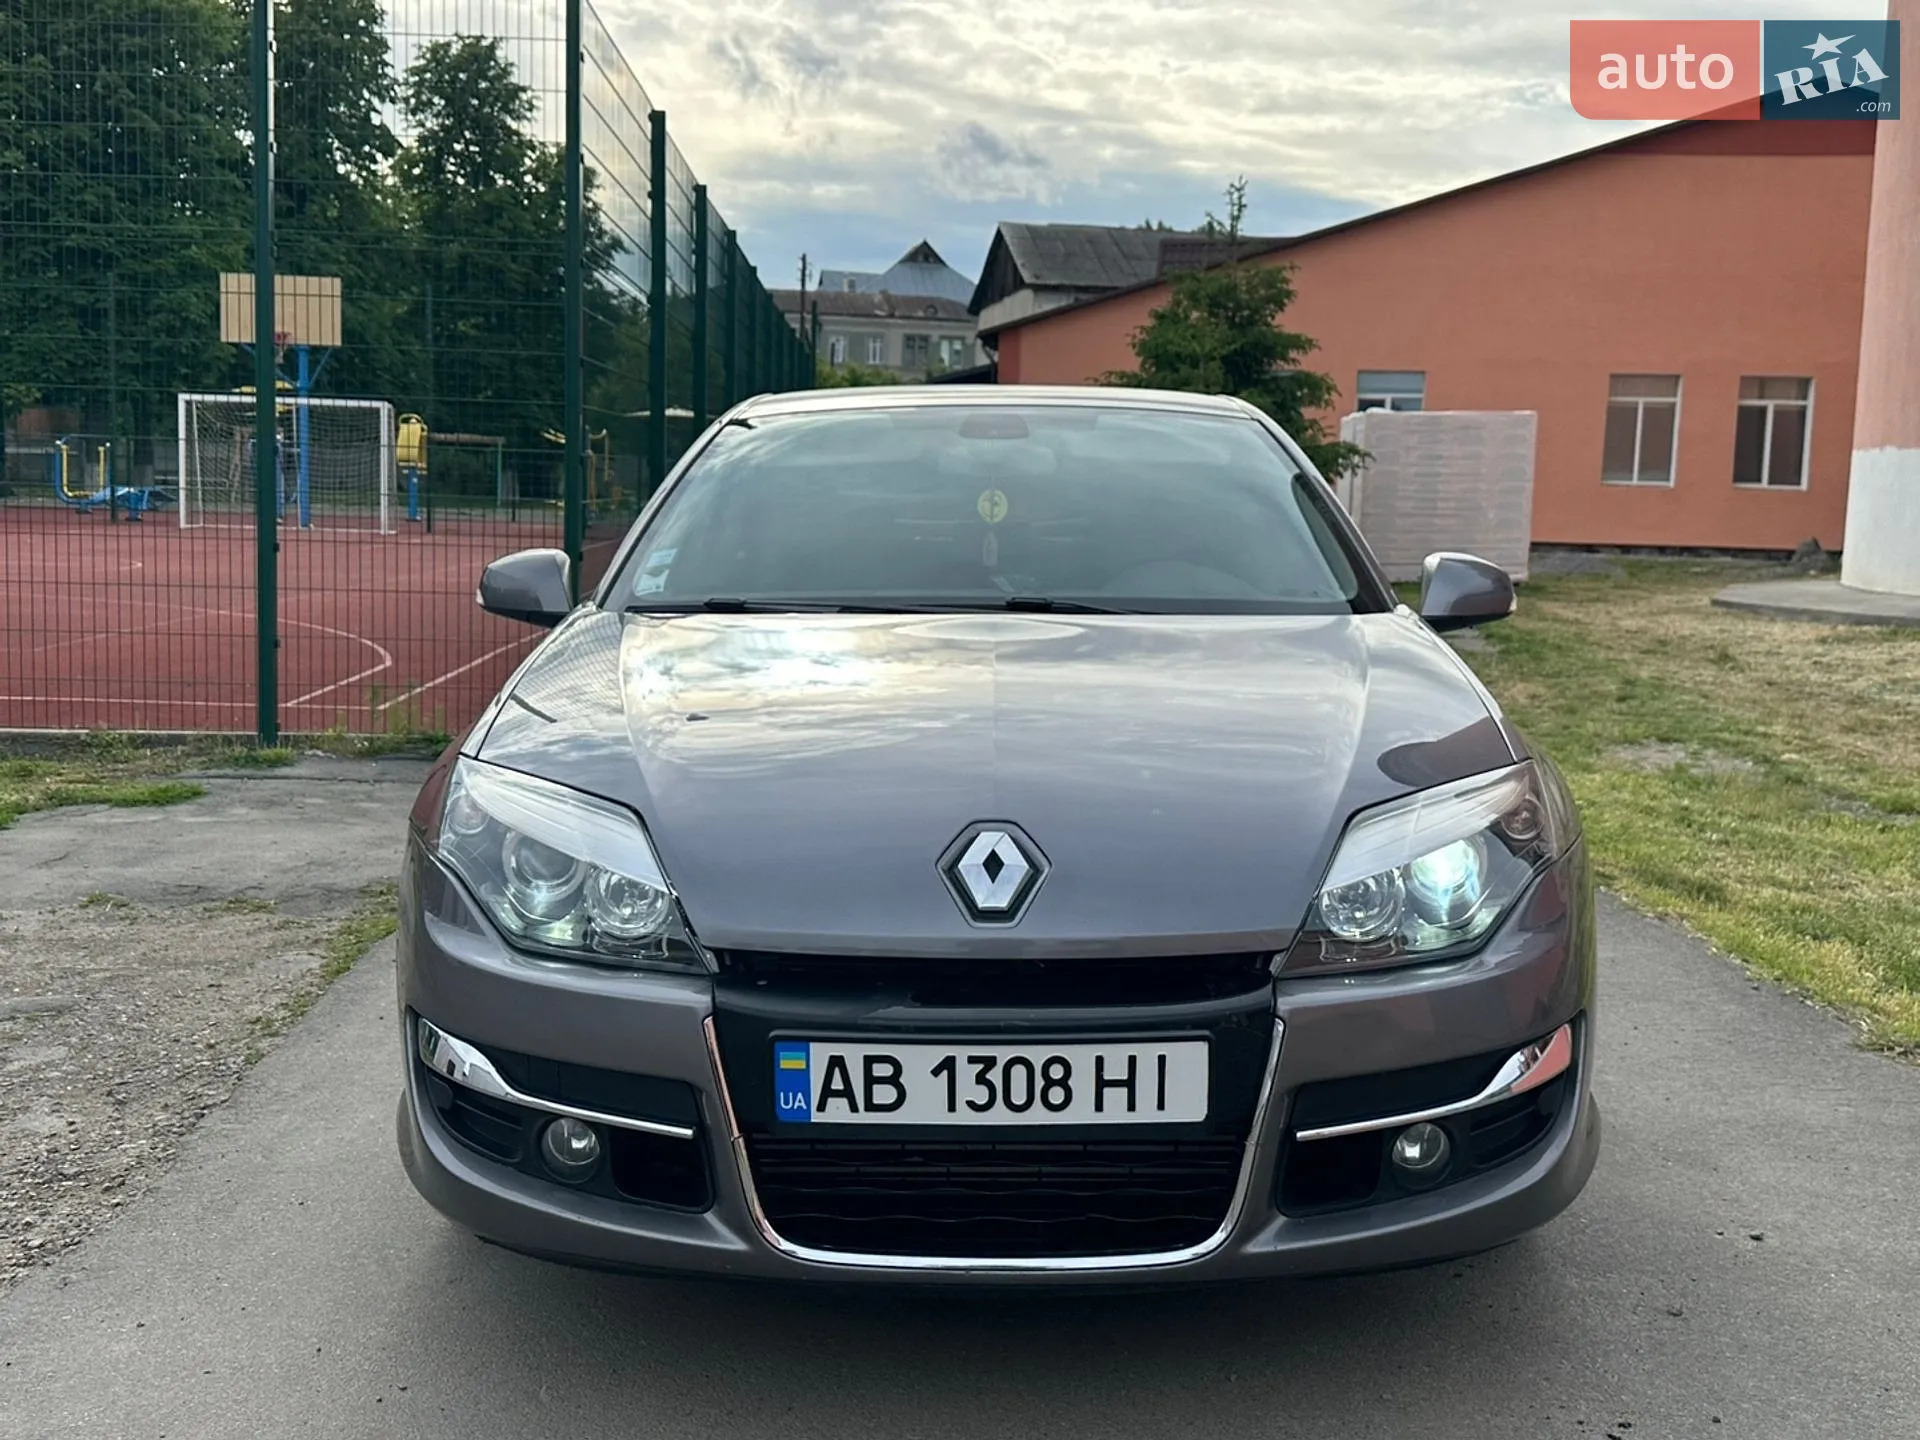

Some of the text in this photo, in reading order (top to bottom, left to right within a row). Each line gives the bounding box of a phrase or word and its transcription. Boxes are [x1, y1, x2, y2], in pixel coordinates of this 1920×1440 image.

[779, 1091, 807, 1110] UA
[815, 1053, 1167, 1113] AB 1308 HI
